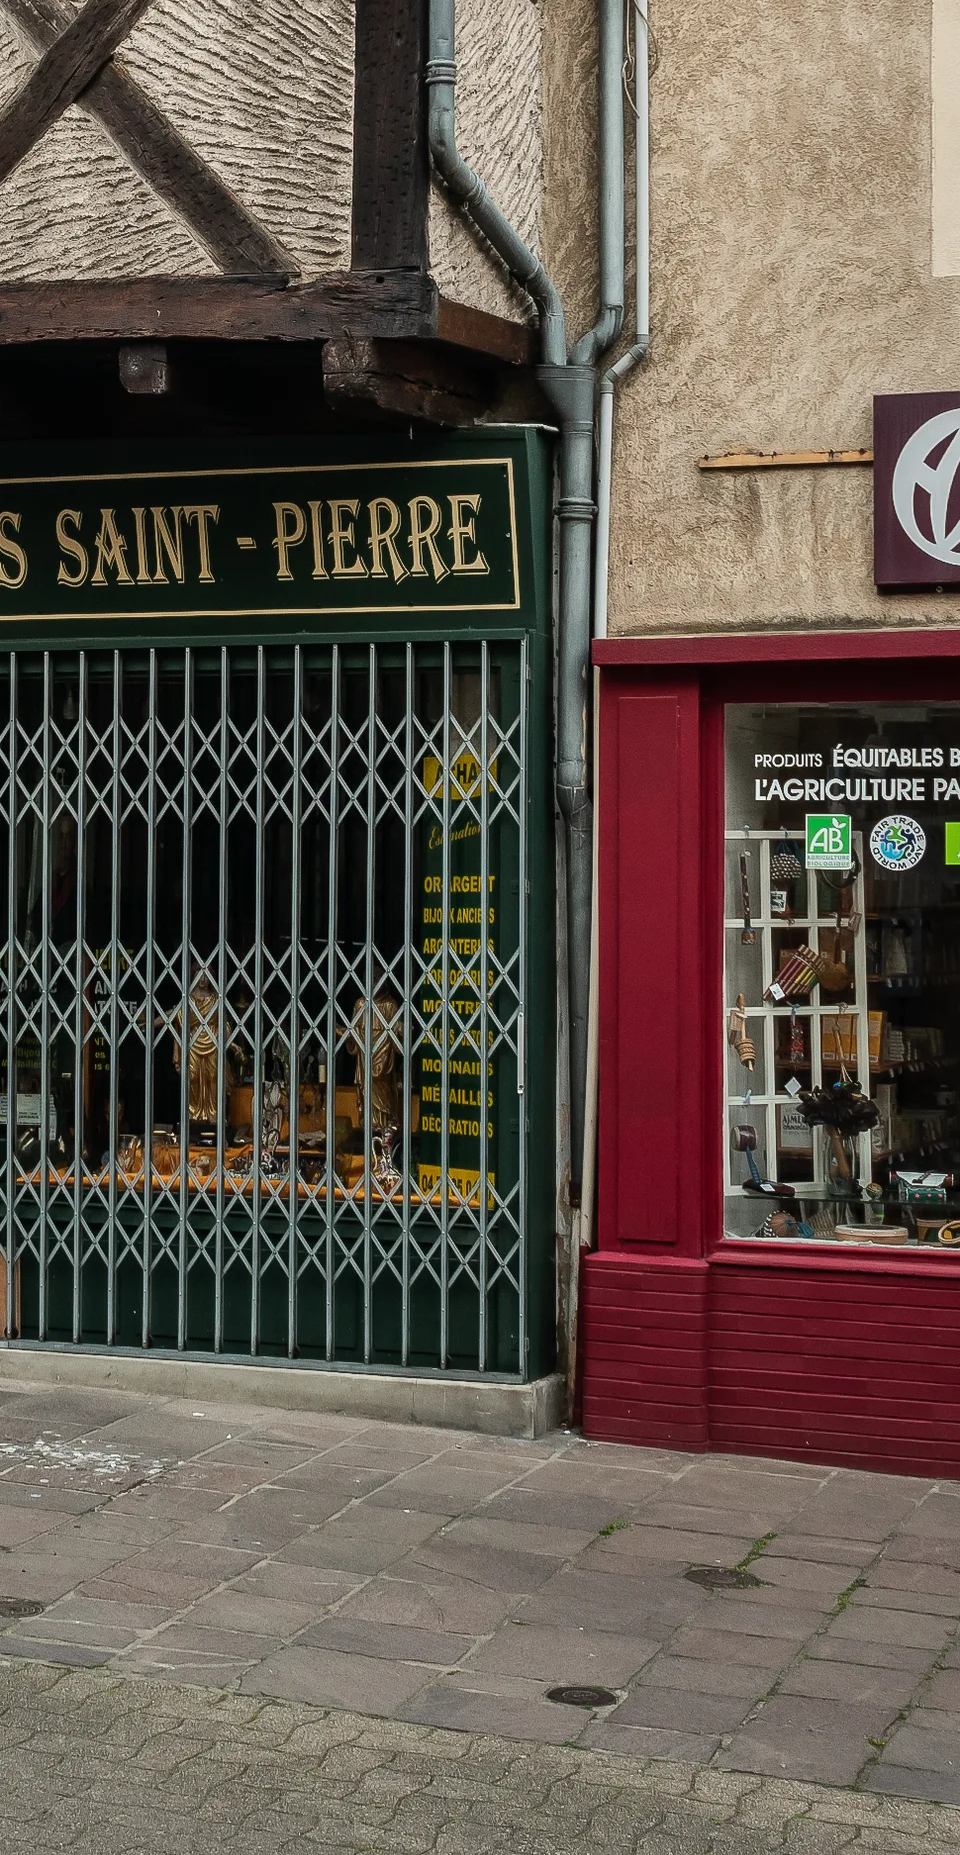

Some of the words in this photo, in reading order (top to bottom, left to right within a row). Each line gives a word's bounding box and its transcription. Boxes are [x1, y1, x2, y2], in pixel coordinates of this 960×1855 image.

[56, 504, 221, 588] SAINT
[271, 493, 490, 586] PIERRE
[754, 753, 823, 768] PRODUITS
[832, 743, 944, 768] ÉQUITABLES
[755, 778, 925, 801] L'AGRICULTURE
[809, 827, 844, 853] AB
[871, 820, 889, 843] FAIR
[891, 816, 925, 842] TRADE
[872, 847, 908, 870] WORLD
[908, 845, 924, 865] DAY
[424, 876, 496, 894] OR-RGET
[423, 908, 454, 924] BIJOX
[456, 908, 495, 924] ANCIES
[422, 1058, 494, 1077] MONAIS
[422, 1083, 494, 1108] MÉAILLS
[421, 1113, 494, 1139] DÉCRATIOS
